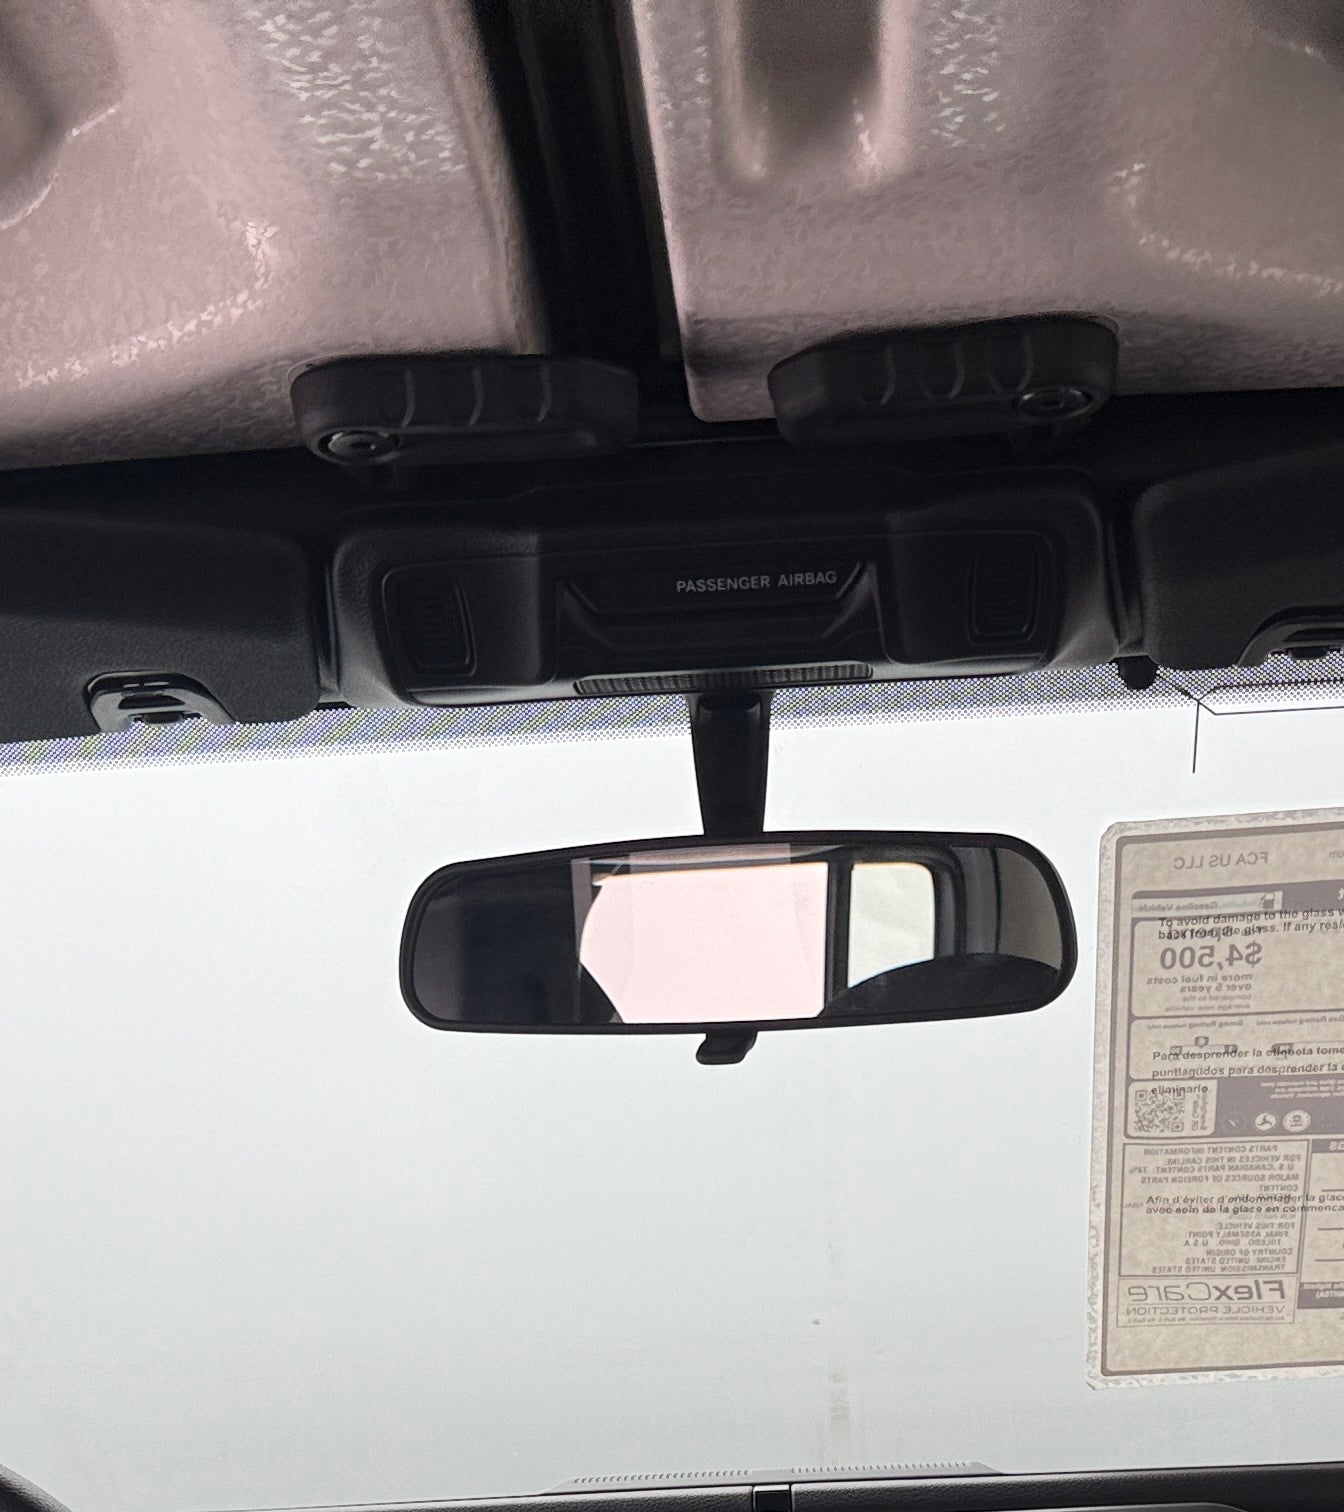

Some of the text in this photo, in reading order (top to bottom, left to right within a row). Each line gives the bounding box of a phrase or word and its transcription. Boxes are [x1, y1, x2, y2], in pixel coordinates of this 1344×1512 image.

[676, 570, 837, 594] PASSENGER AIRBAG
[1159, 917, 1173, 928] To
[1264, 911, 1276, 921] to
[1279, 910, 1299, 920] the
[1302, 908, 1335, 922] glass
[1283, 922, 1291, 933] If
[1294, 921, 1315, 934] any
